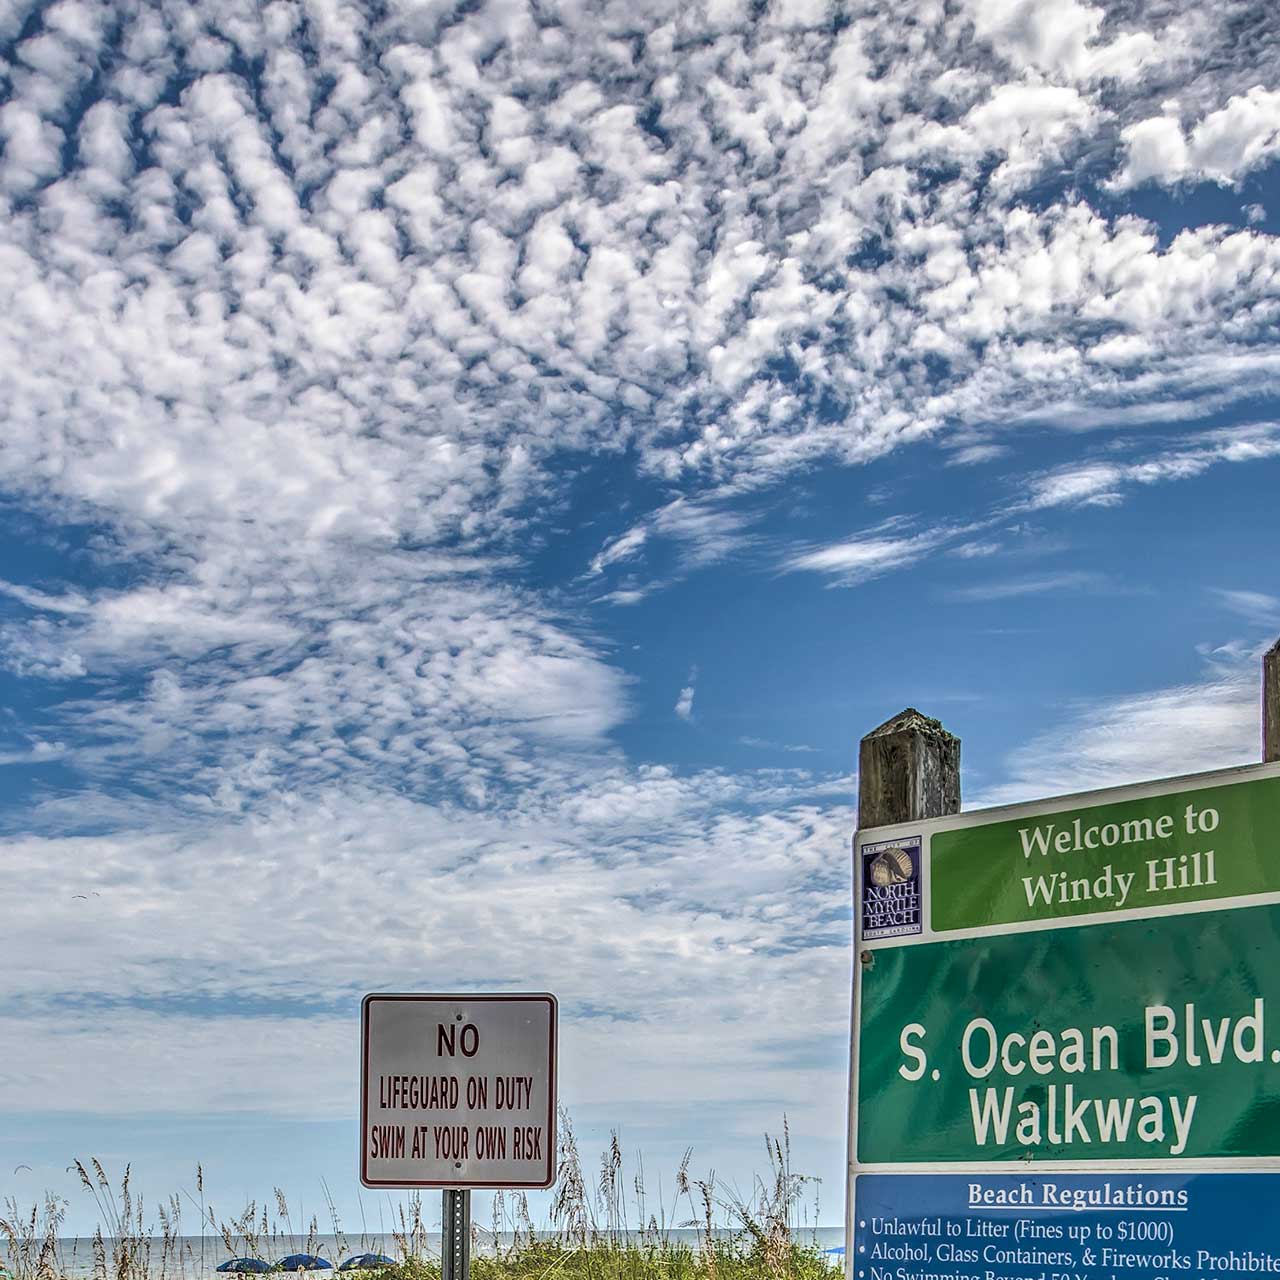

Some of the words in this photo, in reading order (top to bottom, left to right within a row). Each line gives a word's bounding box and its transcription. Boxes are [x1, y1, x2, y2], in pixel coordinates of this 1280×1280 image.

[1018, 815, 1173, 858] Welcome
[1183, 804, 1219, 834] to
[866, 881, 915, 901] NORTH
[1021, 864, 1135, 906] Windy
[1145, 850, 1217, 892] Hill
[865, 896, 917, 915] MYRTLE
[870, 910, 914, 928] BEACH
[437, 1023, 480, 1057] NO
[898, 1023, 940, 1081] S.
[961, 1017, 1118, 1078] Ocean
[1145, 997, 1280, 1068] Blvd.
[380, 1076, 459, 1109] LIFEGUARD
[467, 1076, 488, 1110] ON
[496, 1076, 533, 1110] DUTY
[969, 1083, 1197, 1155] Walkway
[371, 1125, 405, 1159] SWIM
[411, 1126, 428, 1159] AT
[433, 1126, 469, 1160] YOUR
[475, 1127, 506, 1160] OWN
[513, 1127, 542, 1160] RISK
[968, 1183, 1033, 1204] Beach
[1042, 1183, 1188, 1211] Regulations
[871, 1217, 941, 1236] Unlawful
[946, 1221, 961, 1236] to
[966, 1218, 1009, 1237] Litter
[1014, 1219, 1063, 1242] (Fines
[1068, 1226, 1090, 1245] up
[1096, 1223, 1112, 1239] to
[1117, 1220, 1173, 1246] $1000)
[870, 1242, 932, 1263] Alcohol,
[936, 1243, 978, 1262] Glass
[983, 1244, 1076, 1268] Containers,
[1082, 1247, 1096, 1266] &
[1101, 1247, 1191, 1269] Fireworks
